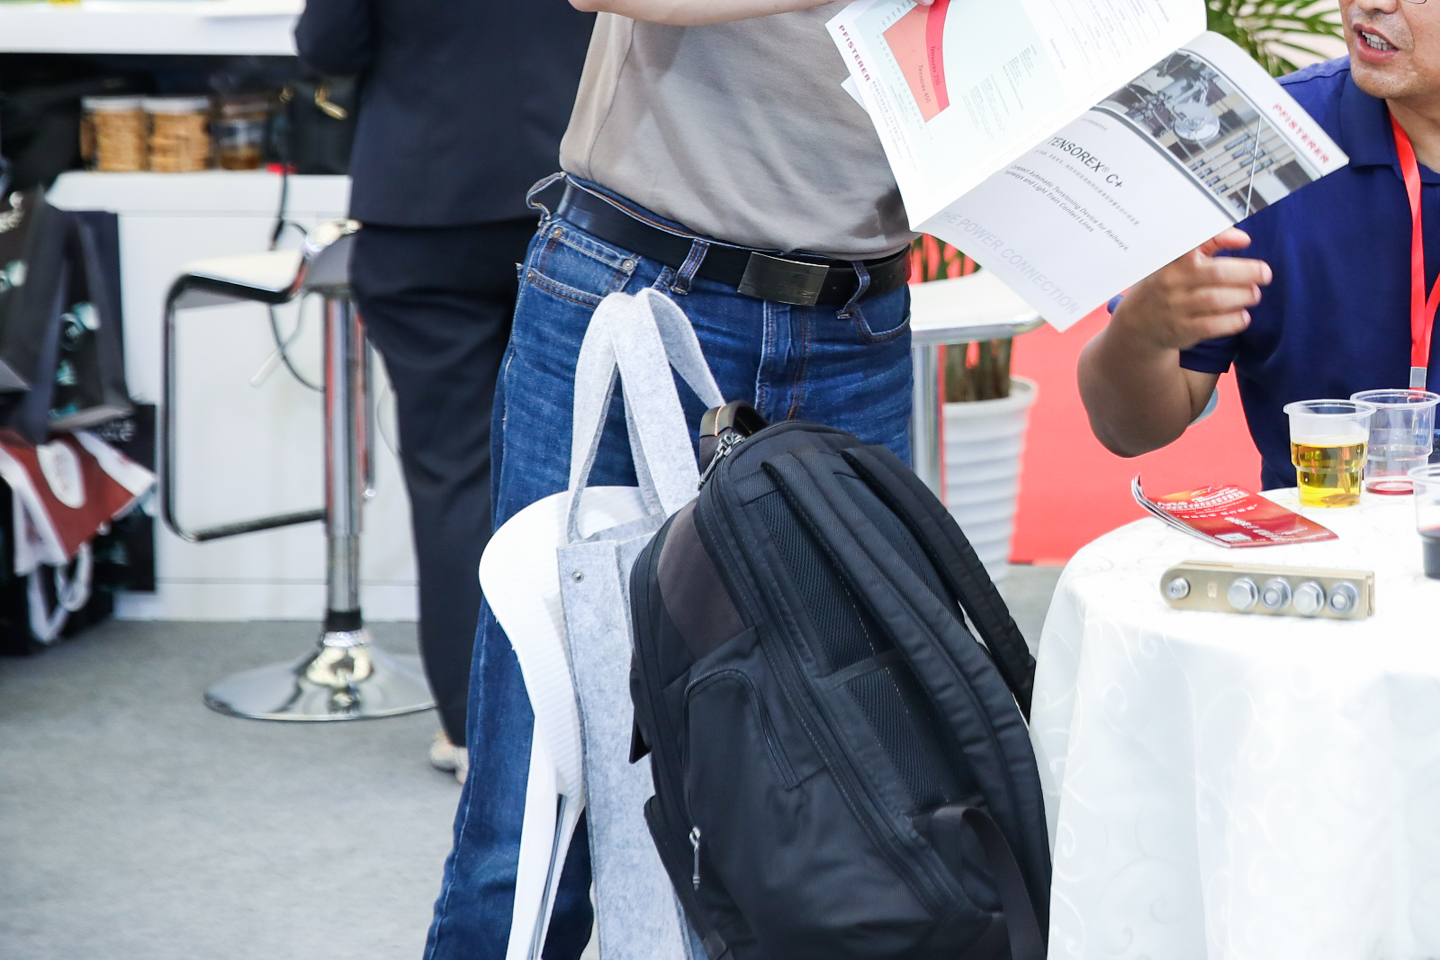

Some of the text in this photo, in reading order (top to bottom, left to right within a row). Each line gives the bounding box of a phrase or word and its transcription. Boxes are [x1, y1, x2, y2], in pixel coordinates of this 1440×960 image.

[838, 24, 871, 82] PFISTERER
[1105, 171, 1124, 187] C+
[1032, 182, 1048, 196] Light
[1045, 192, 1061, 204] Train
[1058, 202, 1081, 220] Contact
[1078, 218, 1094, 232] Lines
[1052, 186, 1081, 210] Tensioning
[1078, 207, 1098, 224] Device
[937, 211, 1081, 314] THE POWER CONNECTION
